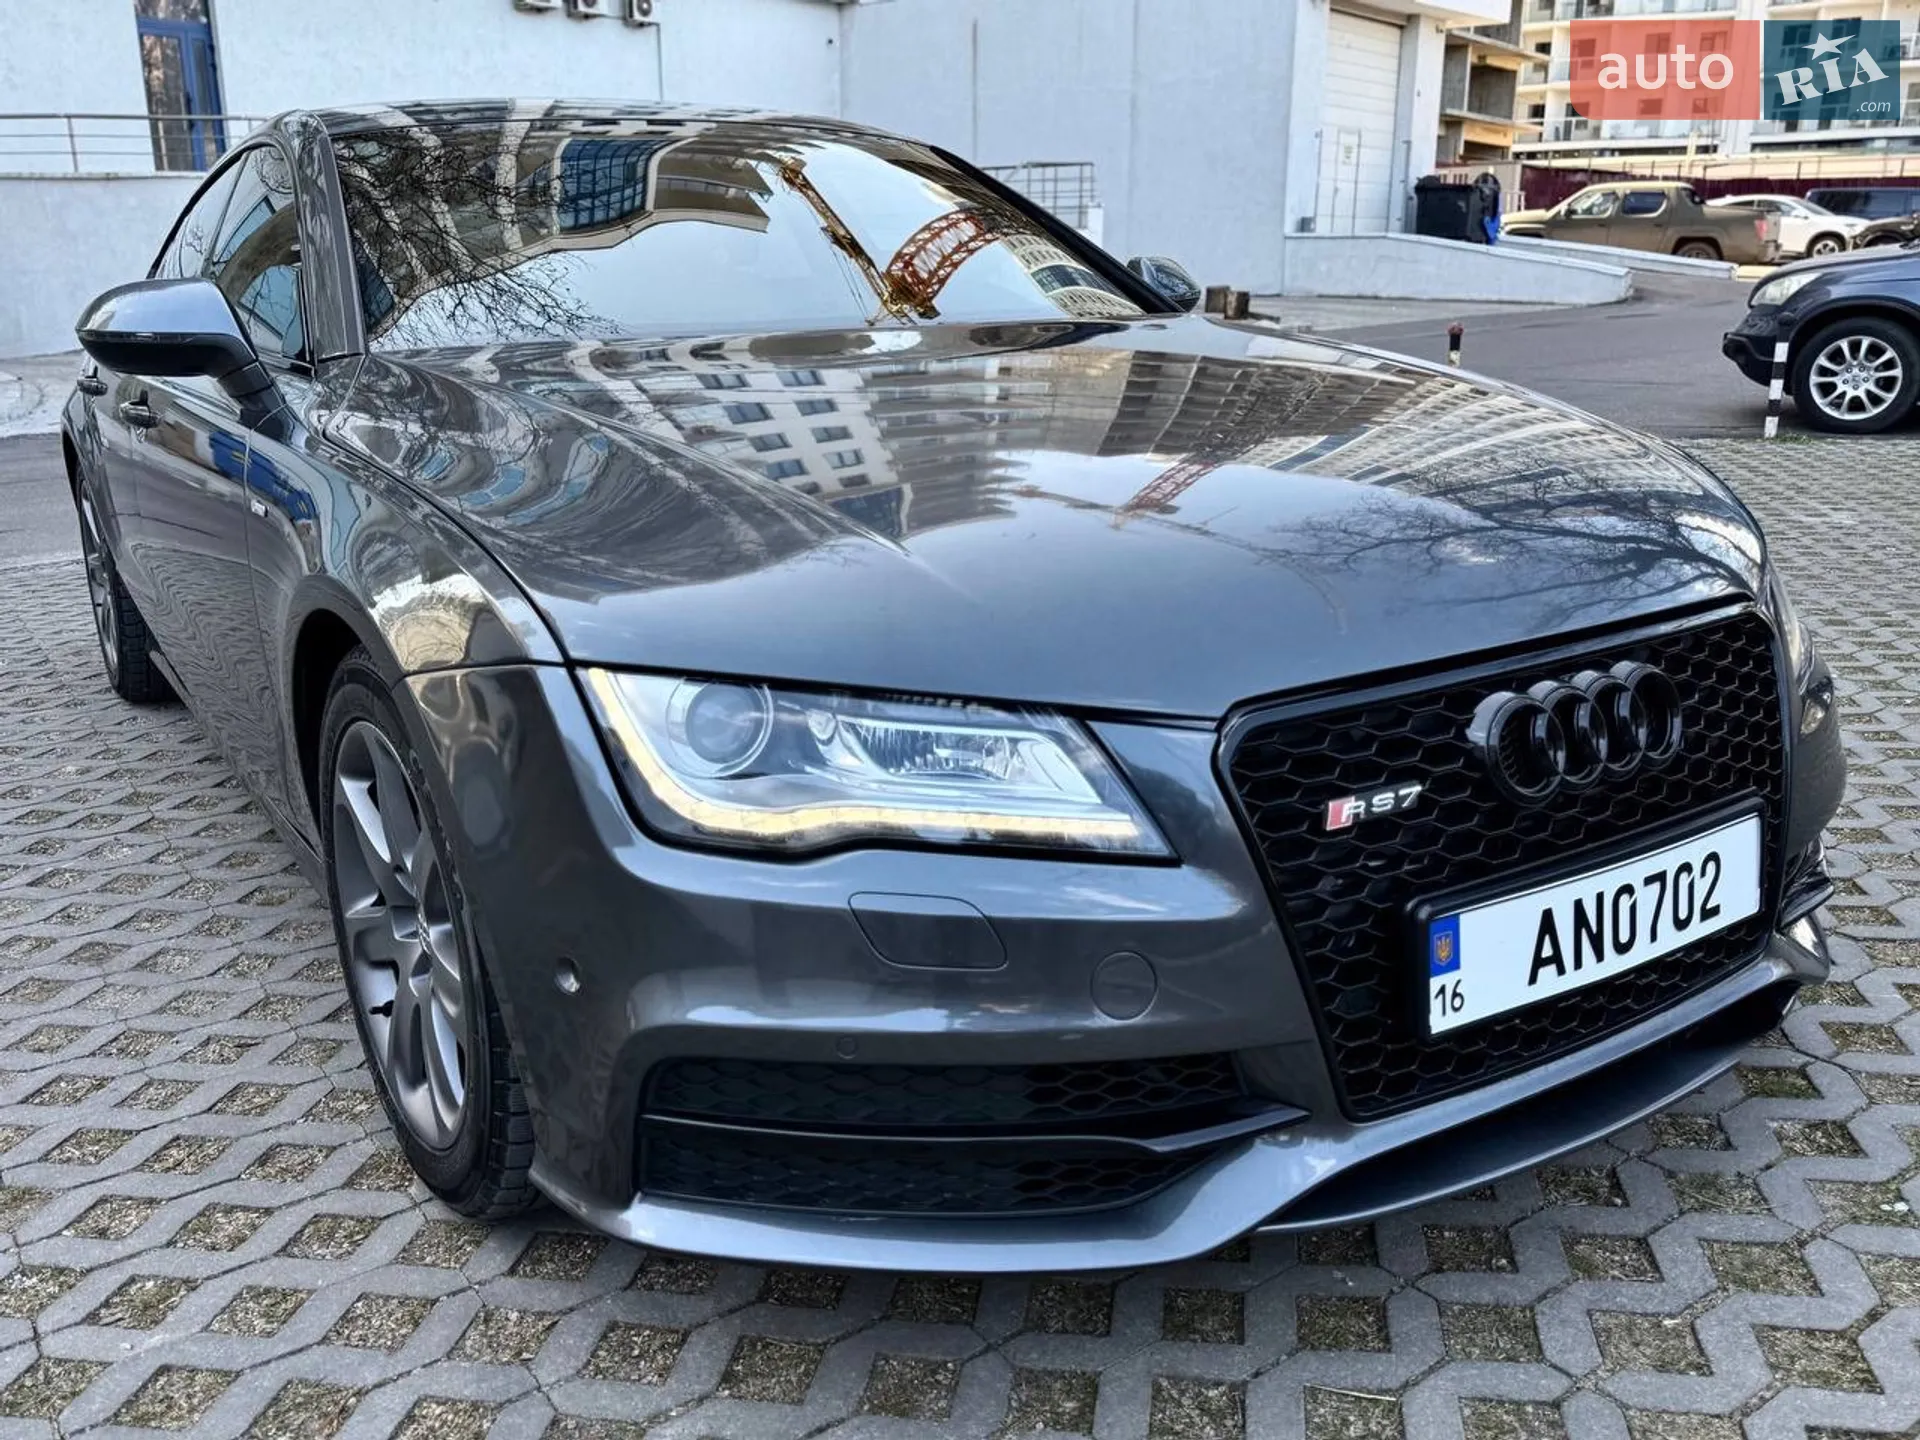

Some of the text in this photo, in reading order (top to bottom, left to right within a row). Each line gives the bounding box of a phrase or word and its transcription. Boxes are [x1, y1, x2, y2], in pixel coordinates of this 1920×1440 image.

[1340, 785, 1422, 823] RS7
[1528, 851, 1721, 986] AN0702
[1434, 979, 1465, 1017] 16
